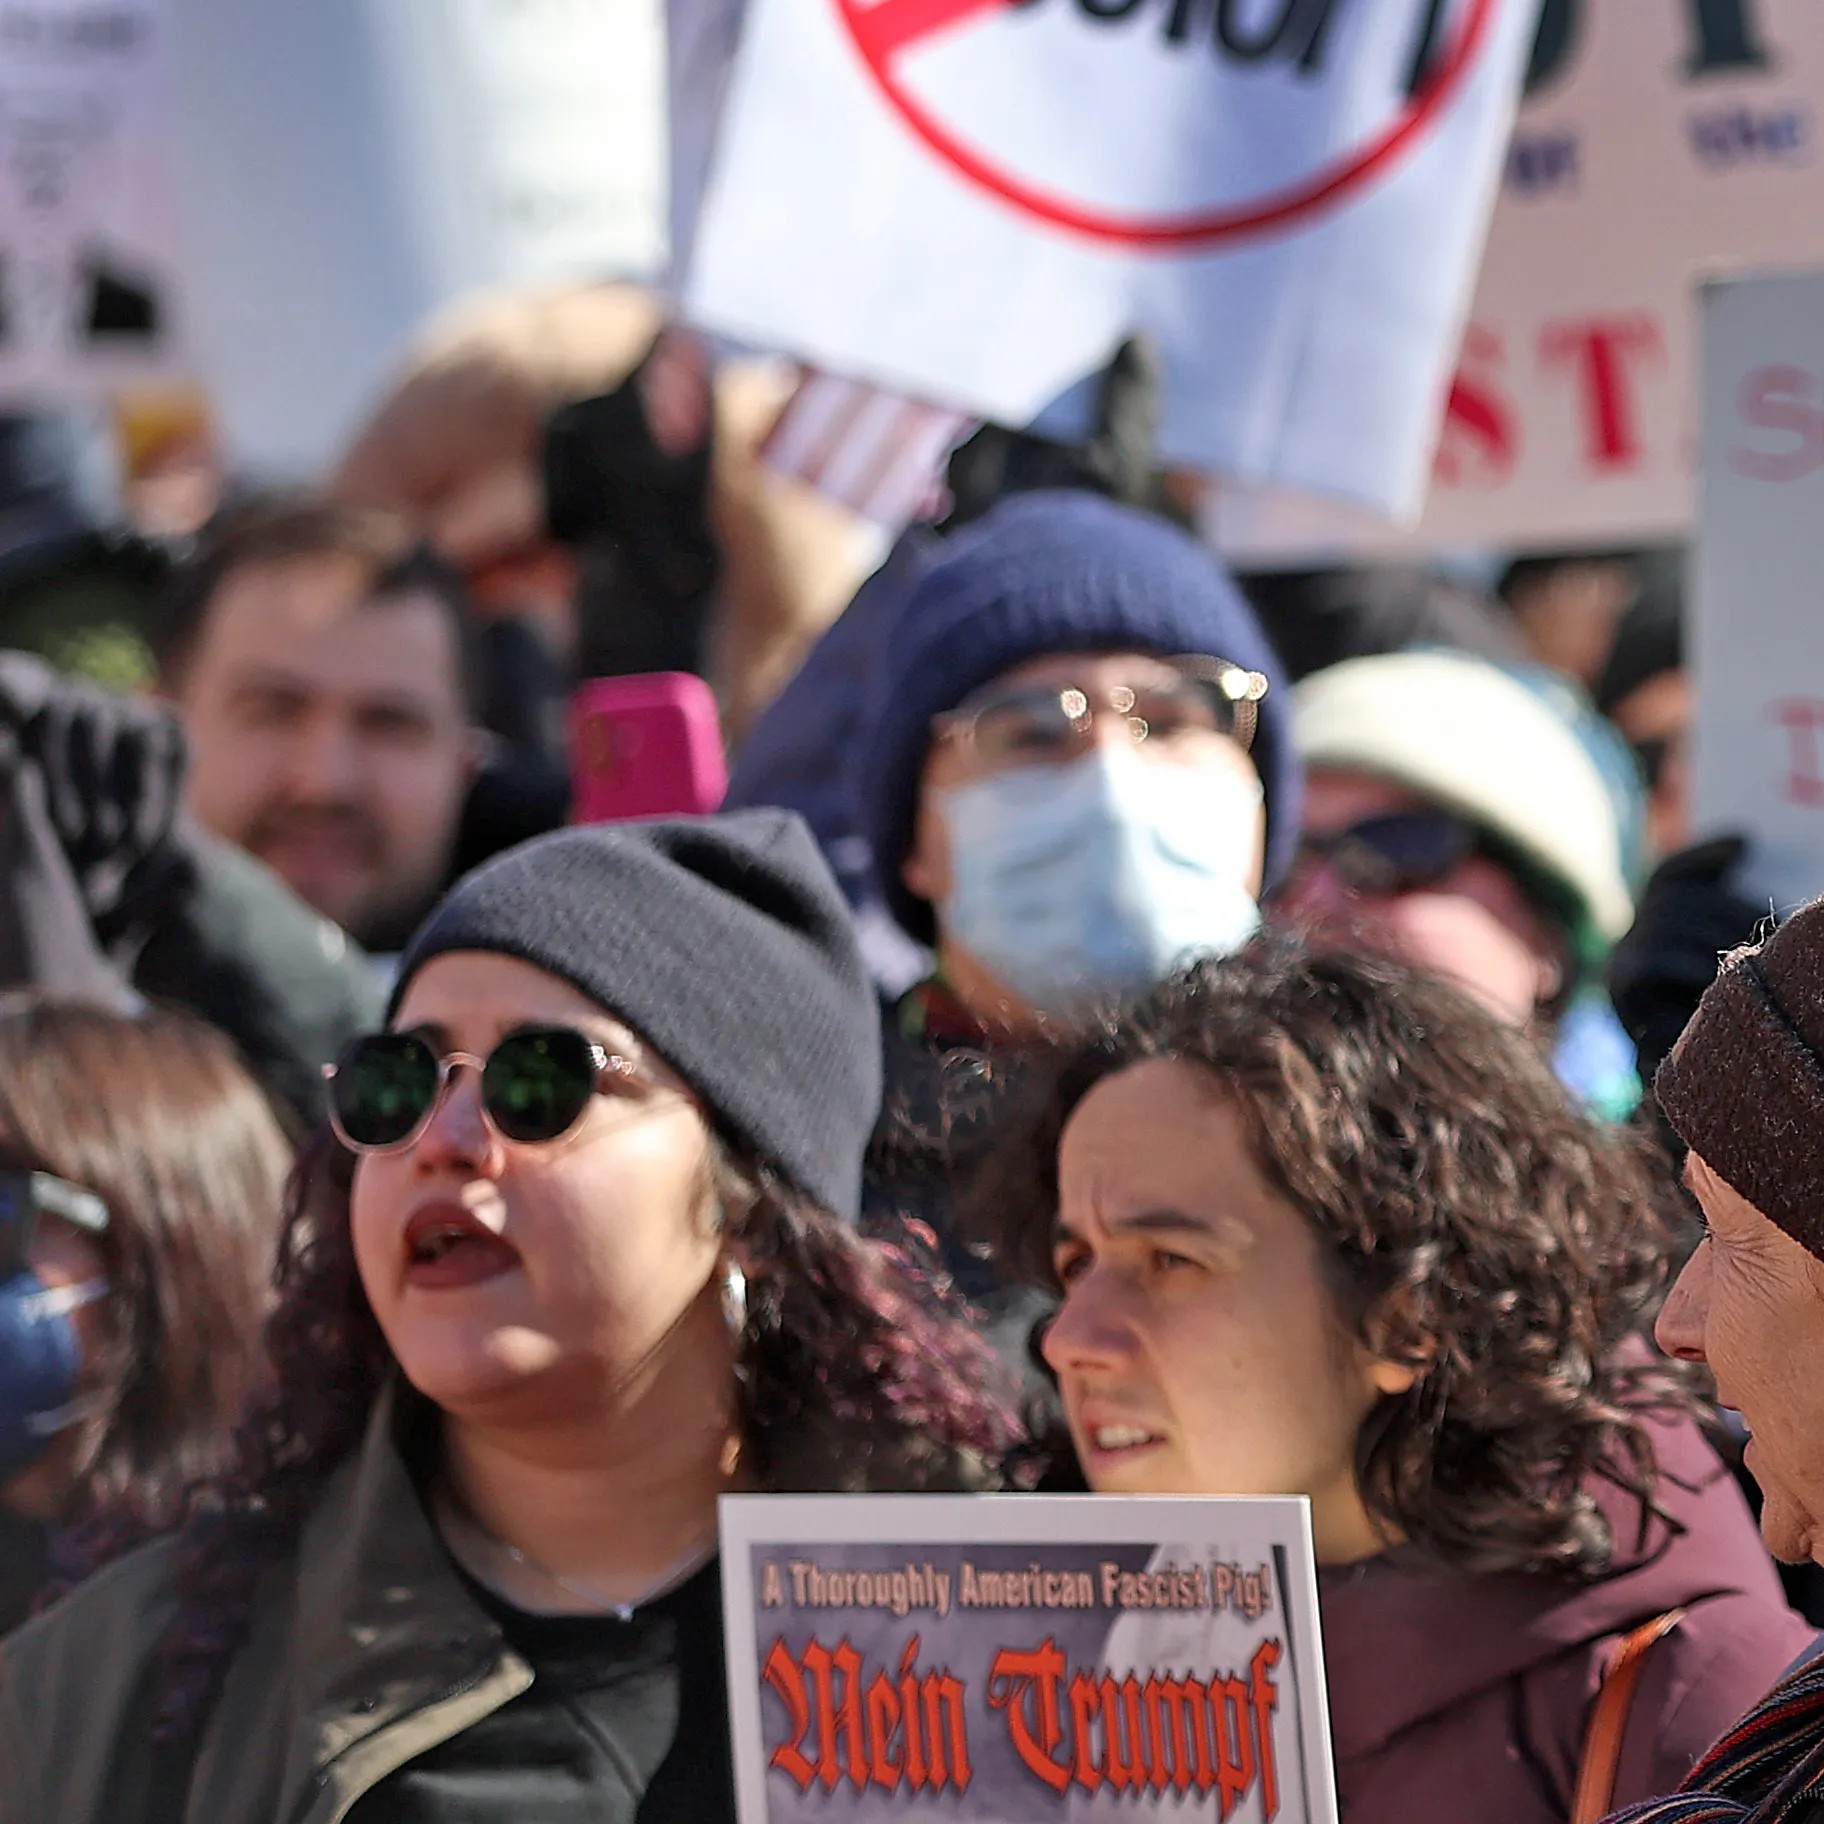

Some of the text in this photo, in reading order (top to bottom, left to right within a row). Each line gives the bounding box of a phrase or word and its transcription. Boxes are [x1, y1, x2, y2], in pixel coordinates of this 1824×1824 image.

[763, 1561, 1273, 1618] A Thoroughly American Fascist Pig!
[763, 1633, 1281, 1824] Mein Trumpf
